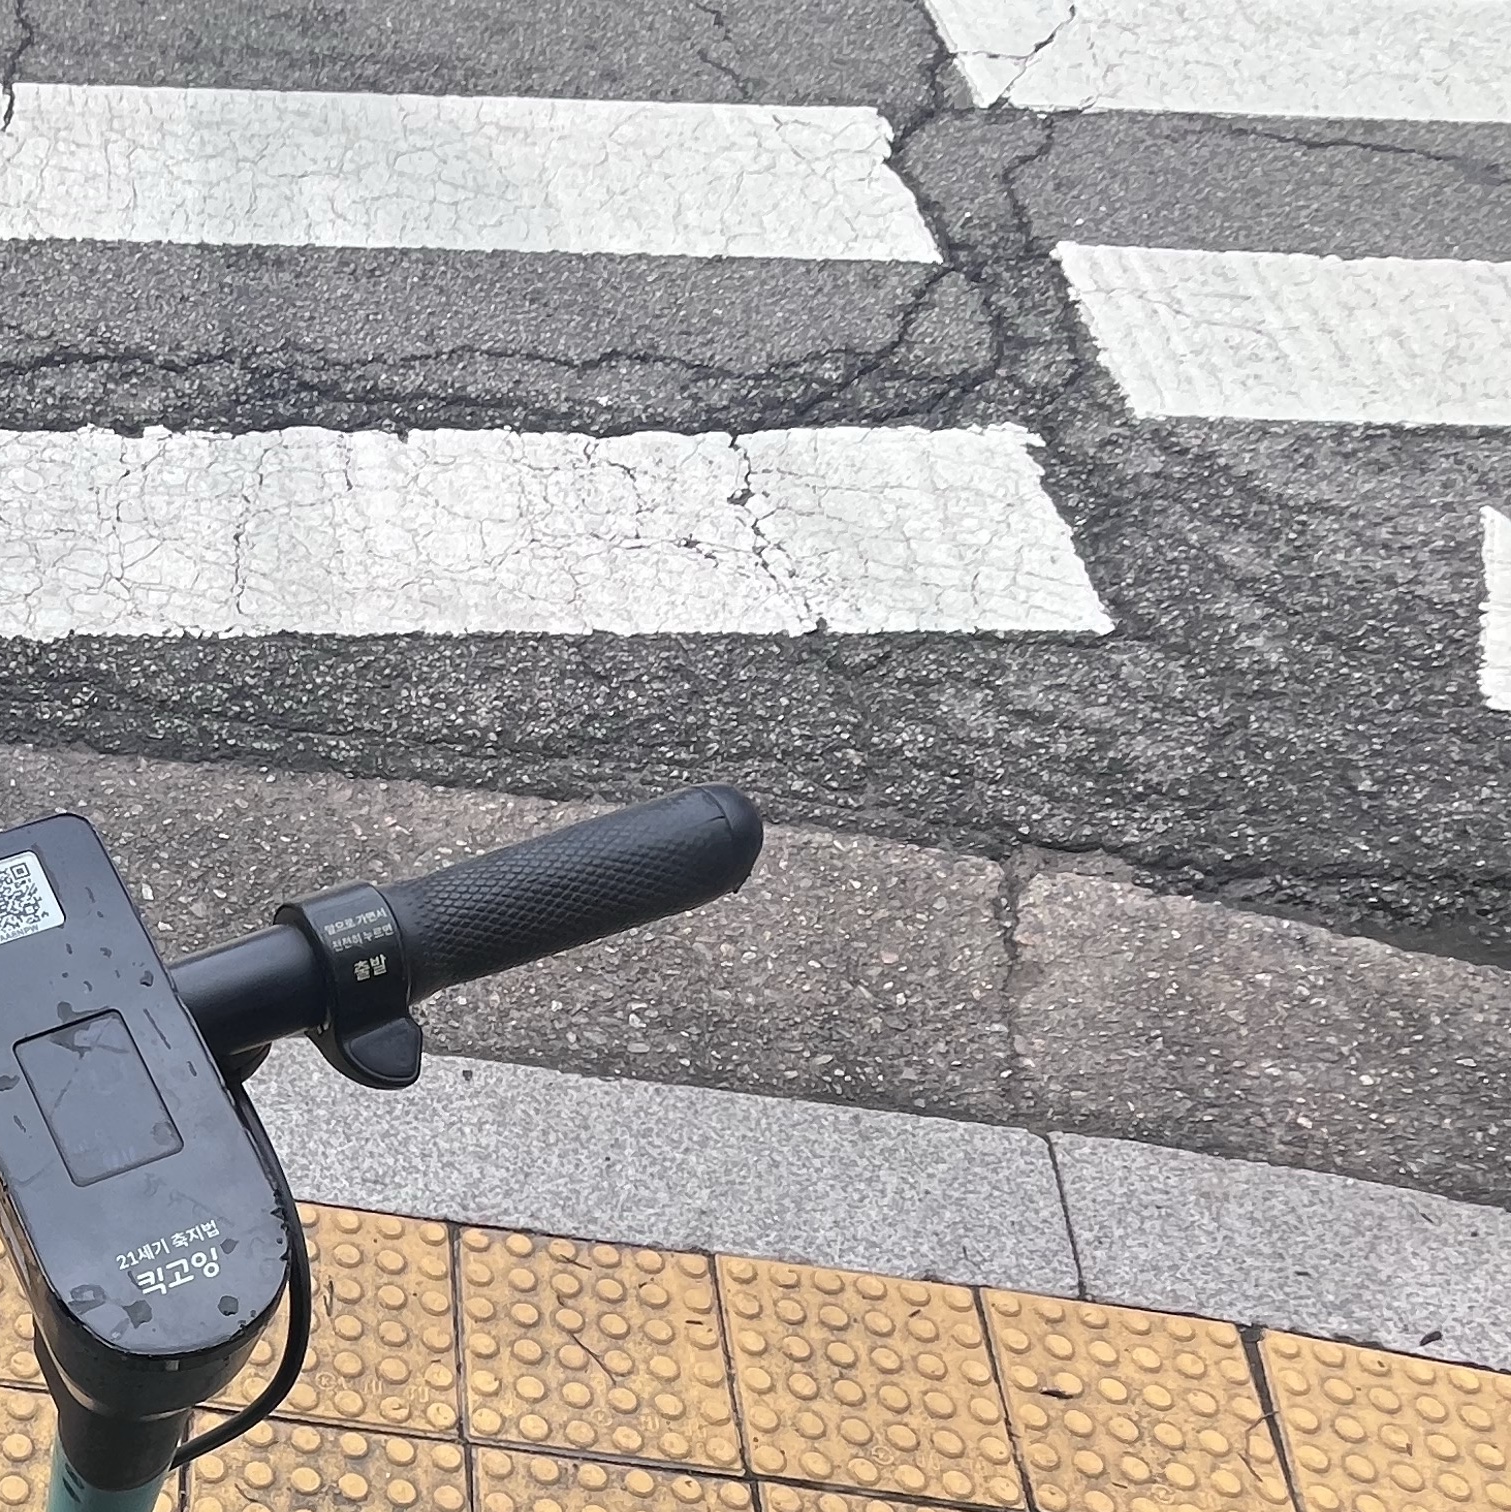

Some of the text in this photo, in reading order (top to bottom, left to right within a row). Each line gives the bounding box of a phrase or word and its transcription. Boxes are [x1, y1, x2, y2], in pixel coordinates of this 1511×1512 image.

[355, 907, 388, 925] 가면서
[363, 923, 395, 942] 누르면
[354, 953, 387, 981] 출발
[116, 1219, 220, 1270] 21세기 축지법
[137, 1247, 220, 1295] 킥고잉
